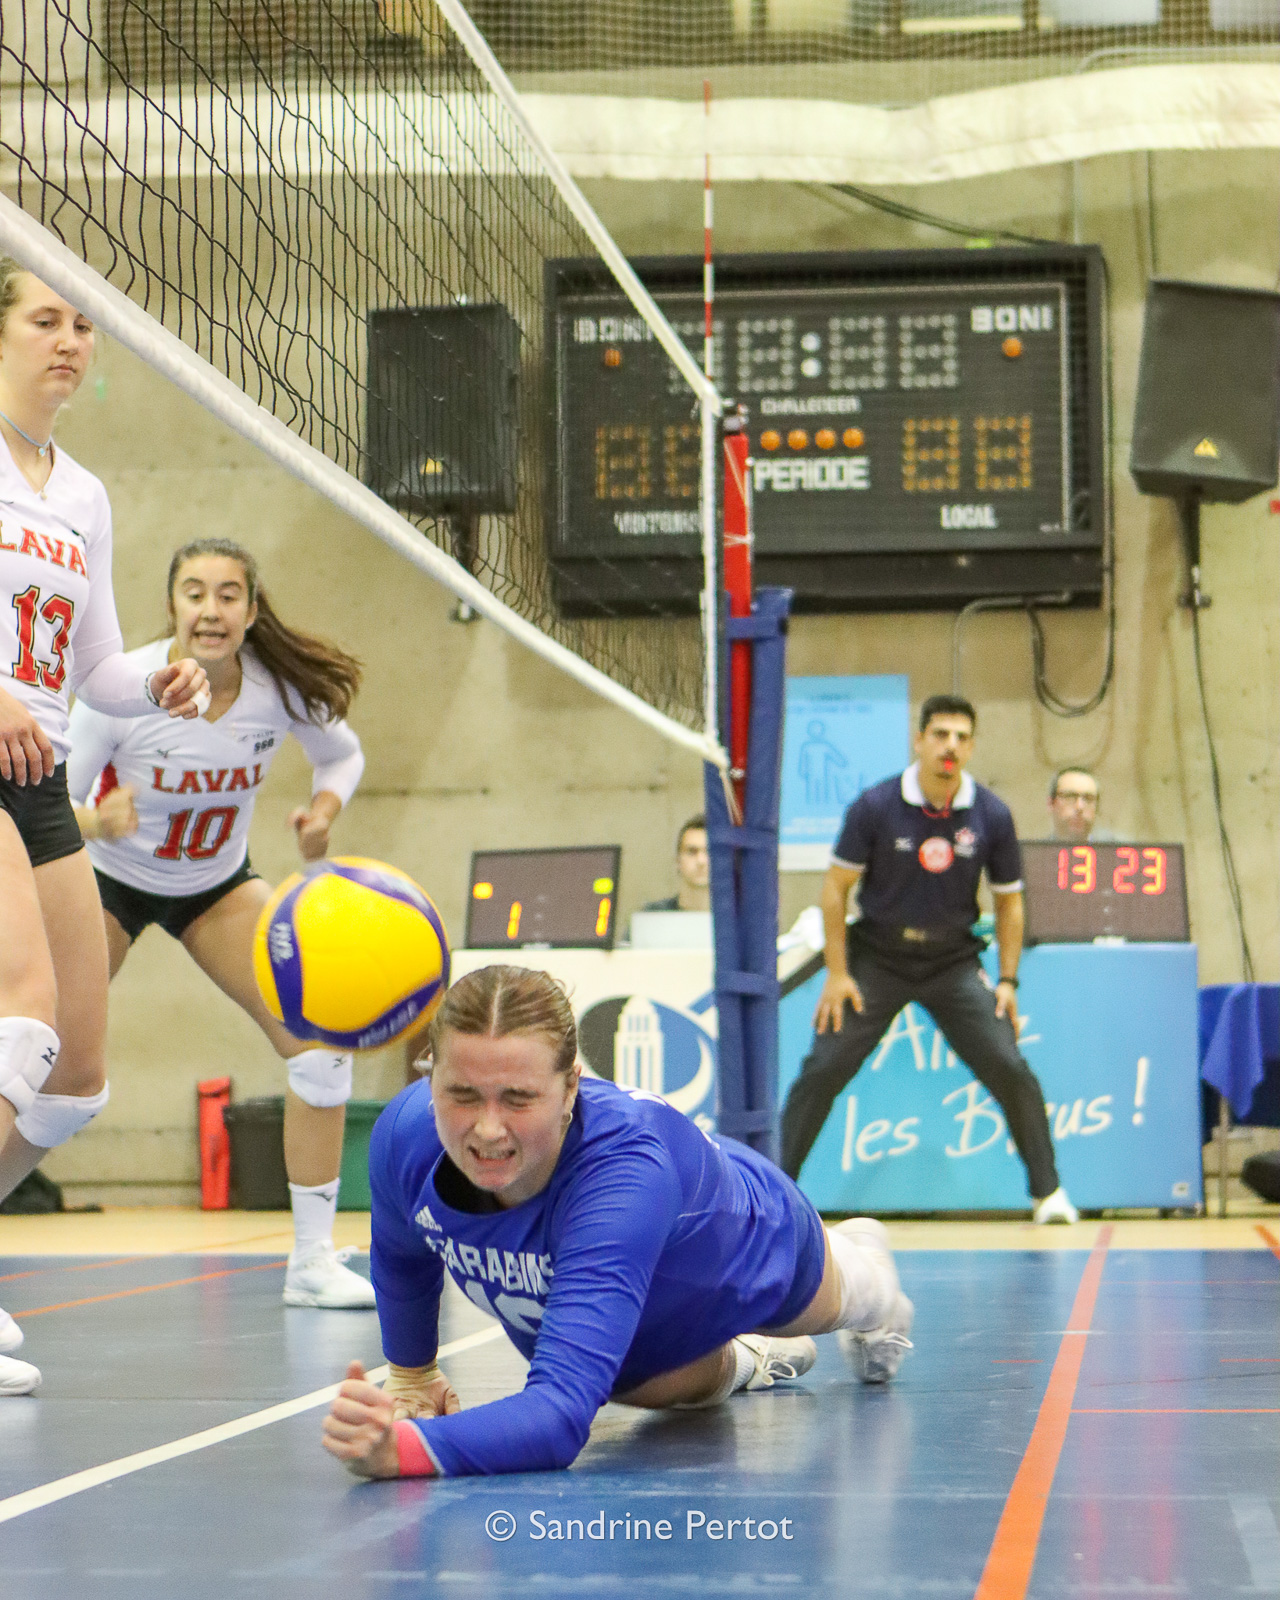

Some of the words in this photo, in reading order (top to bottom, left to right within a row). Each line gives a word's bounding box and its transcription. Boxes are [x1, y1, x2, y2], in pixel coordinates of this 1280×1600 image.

[970, 305, 1053, 333] BONI
[754, 456, 870, 492] PERIODE
[940, 503, 997, 529] LOCAL
[11, 584, 75, 694] 13
[151, 763, 264, 795] LAVAL
[153, 805, 240, 861] 10
[1057, 846, 1097, 893] 13
[1113, 847, 1167, 895] 23
[507, 901, 522, 939] 1
[595, 897, 611, 936] 1
[842, 1094, 920, 1172] les
[941, 1079, 1113, 1157] Bus
